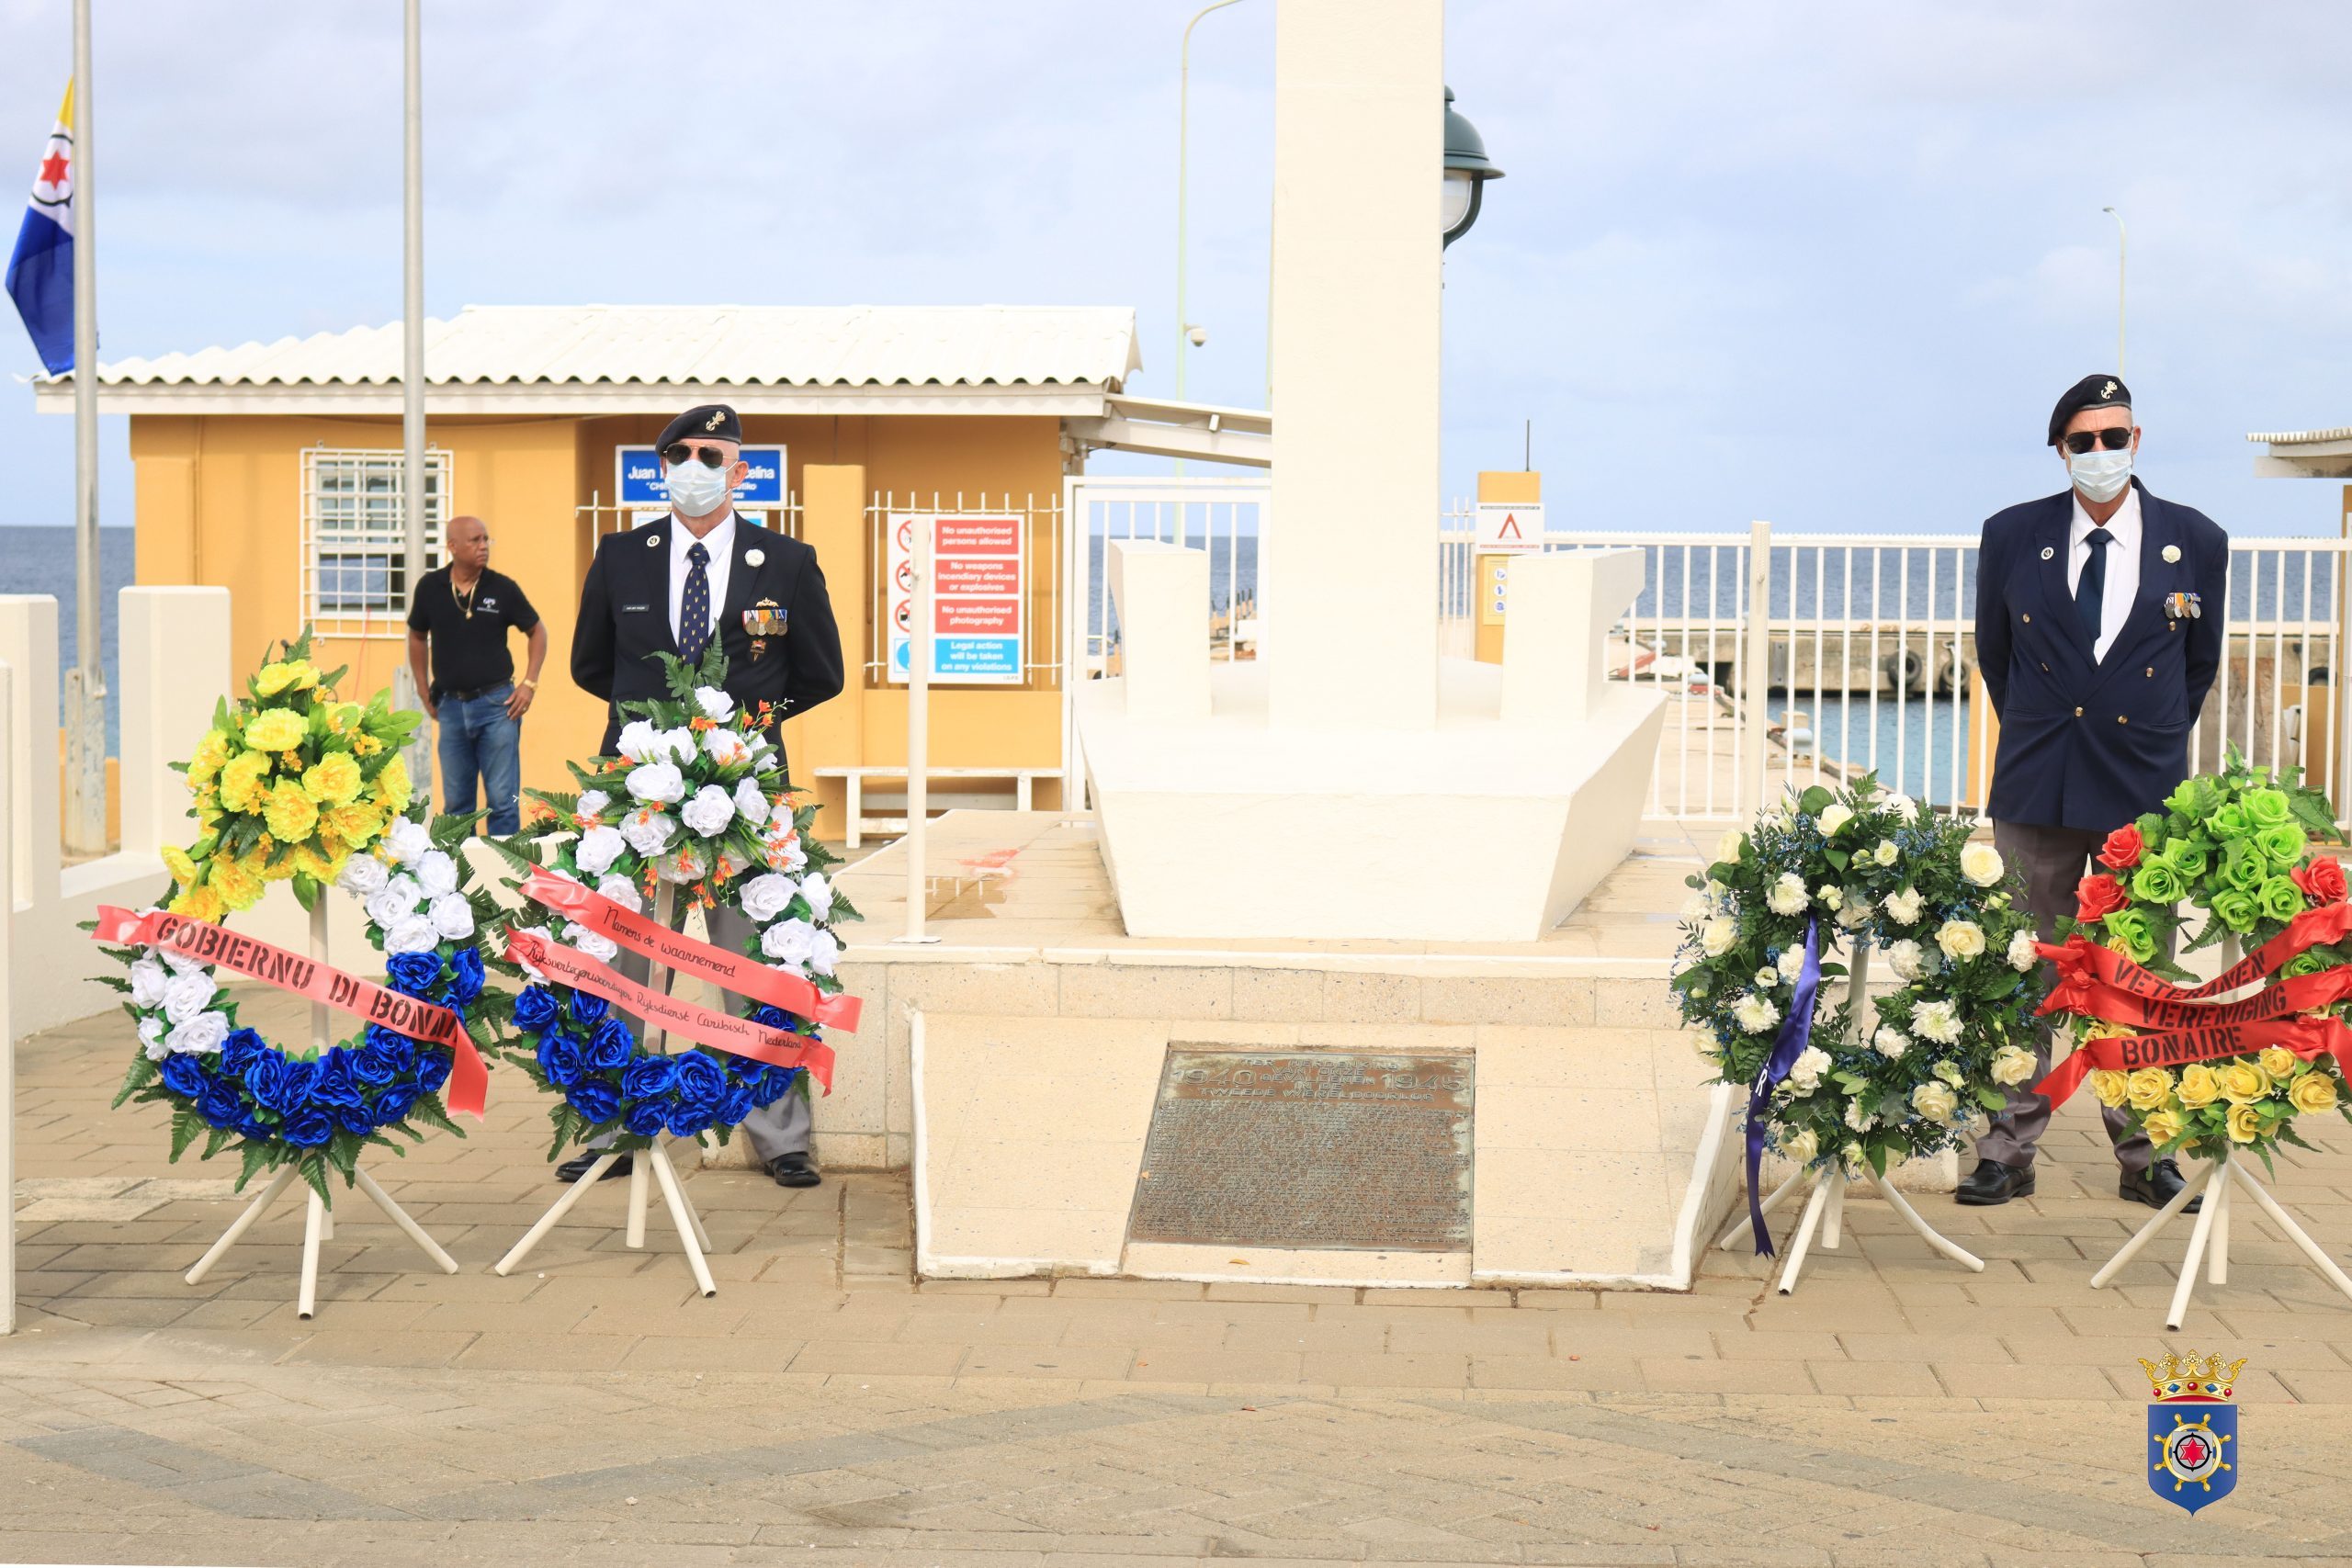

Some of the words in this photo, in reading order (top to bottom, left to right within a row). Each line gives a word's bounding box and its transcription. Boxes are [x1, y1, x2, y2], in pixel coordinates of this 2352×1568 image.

[628, 466, 656, 479] Juan
[942, 526, 955, 535] No
[956, 525, 1012, 535] unauthorised
[942, 538, 977, 547] persons
[978, 536, 1012, 546] allowed
[951, 561, 963, 570] No
[965, 563, 1003, 571] weapons
[938, 572, 982, 582] incendiary
[983, 572, 1016, 581] devices
[960, 582, 1005, 592] explosives
[942, 605, 955, 614] No
[956, 605, 1012, 615] unauthorised
[949, 615, 1004, 626] photography
[951, 641, 974, 650] Legal
[976, 641, 1003, 650] action
[950, 652, 965, 660] will
[967, 652, 978, 660] be
[979, 652, 1003, 660] taken
[955, 664, 969, 673] any
[971, 662, 1012, 671] violations
[604, 906, 641, 942] Namens
[643, 935, 654, 948] de
[661, 942, 736, 977] waarnemend
[156, 917, 316, 990] GOBIERNU
[328, 975, 360, 1008] DI
[368, 989, 458, 1043] BONAI
[2113, 951, 2265, 1000] VETERANEN
[2142, 986, 2287, 1029] VERENIGING
[636, 992, 689, 1022] Rijksdienst
[696, 1012, 750, 1036] Caribisch
[758, 1029, 802, 1050] Nederland
[2120, 1026, 2247, 1066] BONAIRE
[1171, 1067, 1257, 1087] 1940
[1381, 1073, 1465, 1091] 1945
[1199, 1088, 1276, 1097] TWEEDE
